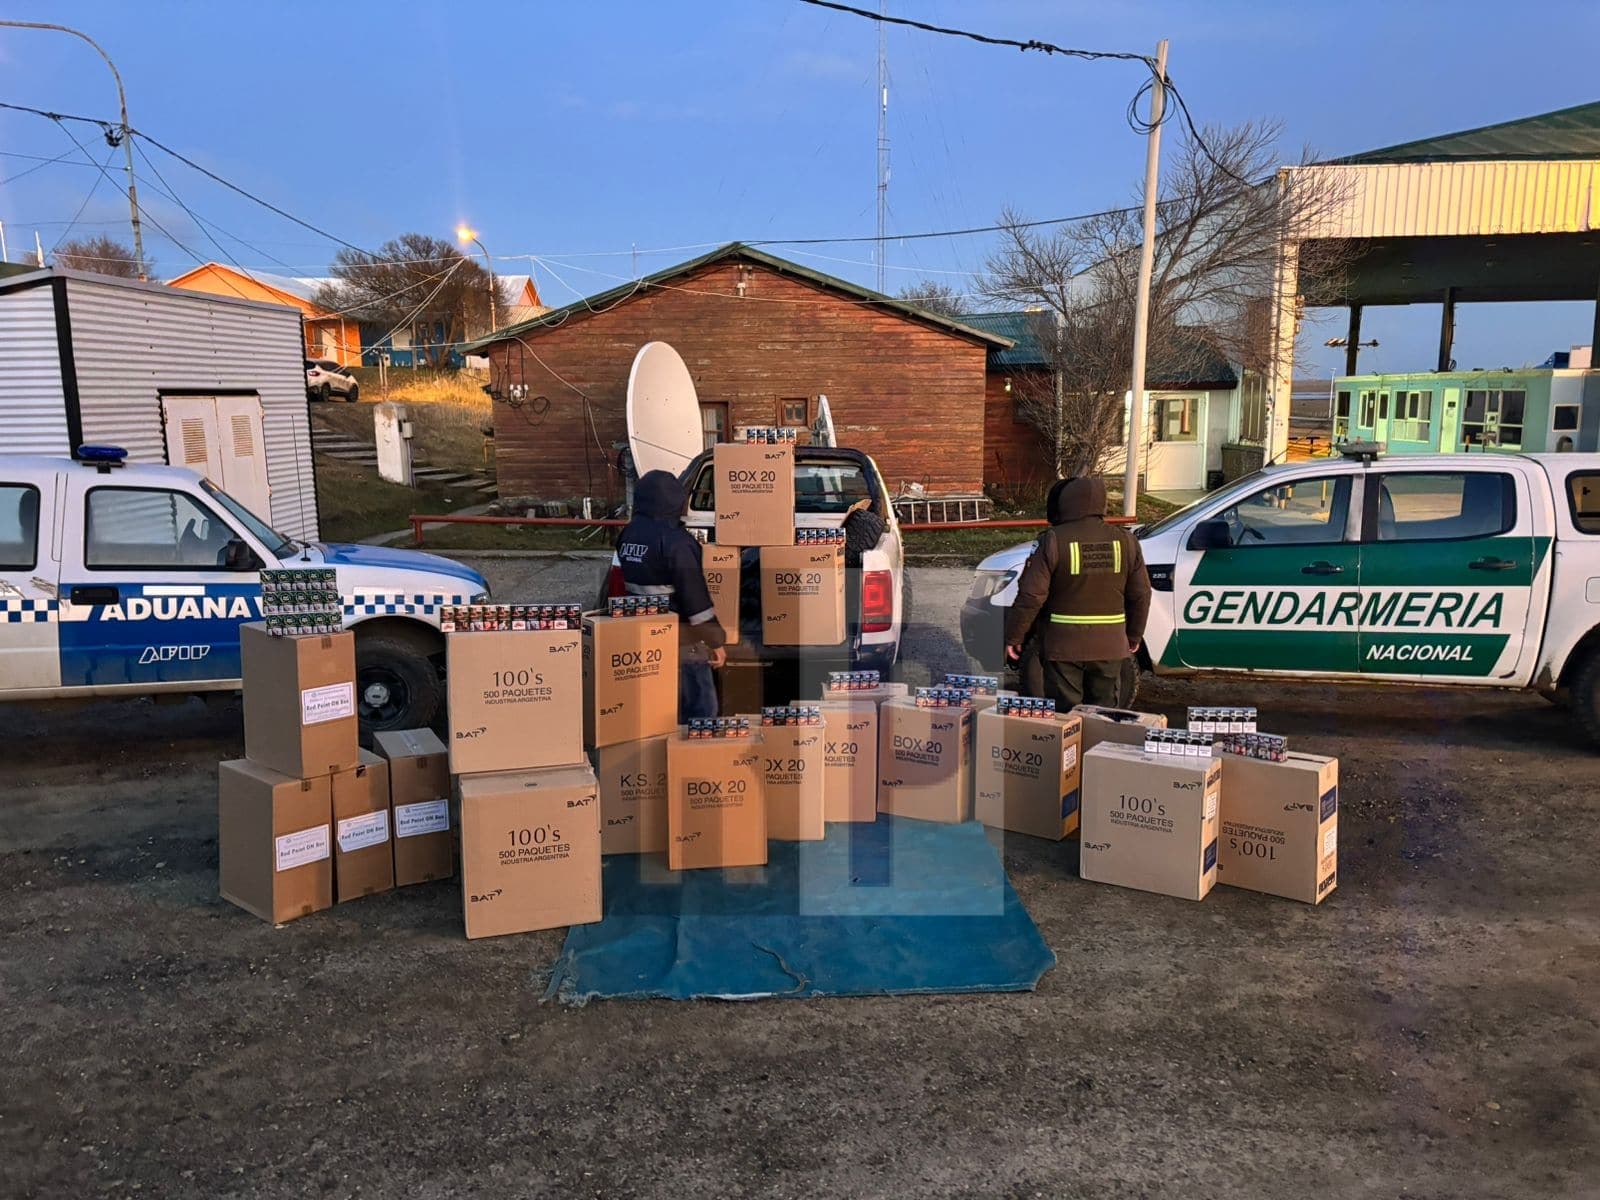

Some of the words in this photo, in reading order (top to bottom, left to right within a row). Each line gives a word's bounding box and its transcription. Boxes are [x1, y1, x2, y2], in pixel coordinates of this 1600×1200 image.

[728, 470, 756, 482] BOX
[760, 470, 776, 482] 20
[708, 573, 722, 583] 20
[776, 573, 802, 584] BOX
[807, 573, 821, 584] 20
[100, 597, 252, 621] ADUANA
[1183, 590, 1504, 628] GENDARMERIA
[138, 645, 210, 664] AFIP
[612, 651, 642, 668] BOX
[646, 649, 662, 662] 20
[1366, 644, 1474, 661] NACIONAL
[493, 667, 543, 687] 100's
[502, 687, 552, 697] PAQUETES
[841, 742, 858, 754] 20
[894, 736, 922, 751] BOX
[927, 741, 942, 754] 20
[992, 746, 1021, 763] BOX
[1026, 753, 1042, 766] 20
[766, 759, 783, 772] OX
[788, 759, 805, 772] 20
[620, 774, 651, 787] K.S.
[657, 773, 666, 785] 2
[688, 781, 722, 795] BOX
[728, 780, 746, 793] 20
[1120, 795, 1165, 816] 100's
[1110, 810, 1124, 819] 500
[1127, 813, 1174, 828] PAQUETES
[508, 824, 560, 846] 100's
[1222, 827, 1268, 842] PAQUETES
[1270, 836, 1285, 845] 500
[499, 850, 515, 859] 500
[518, 844, 570, 856] PAQUETES
